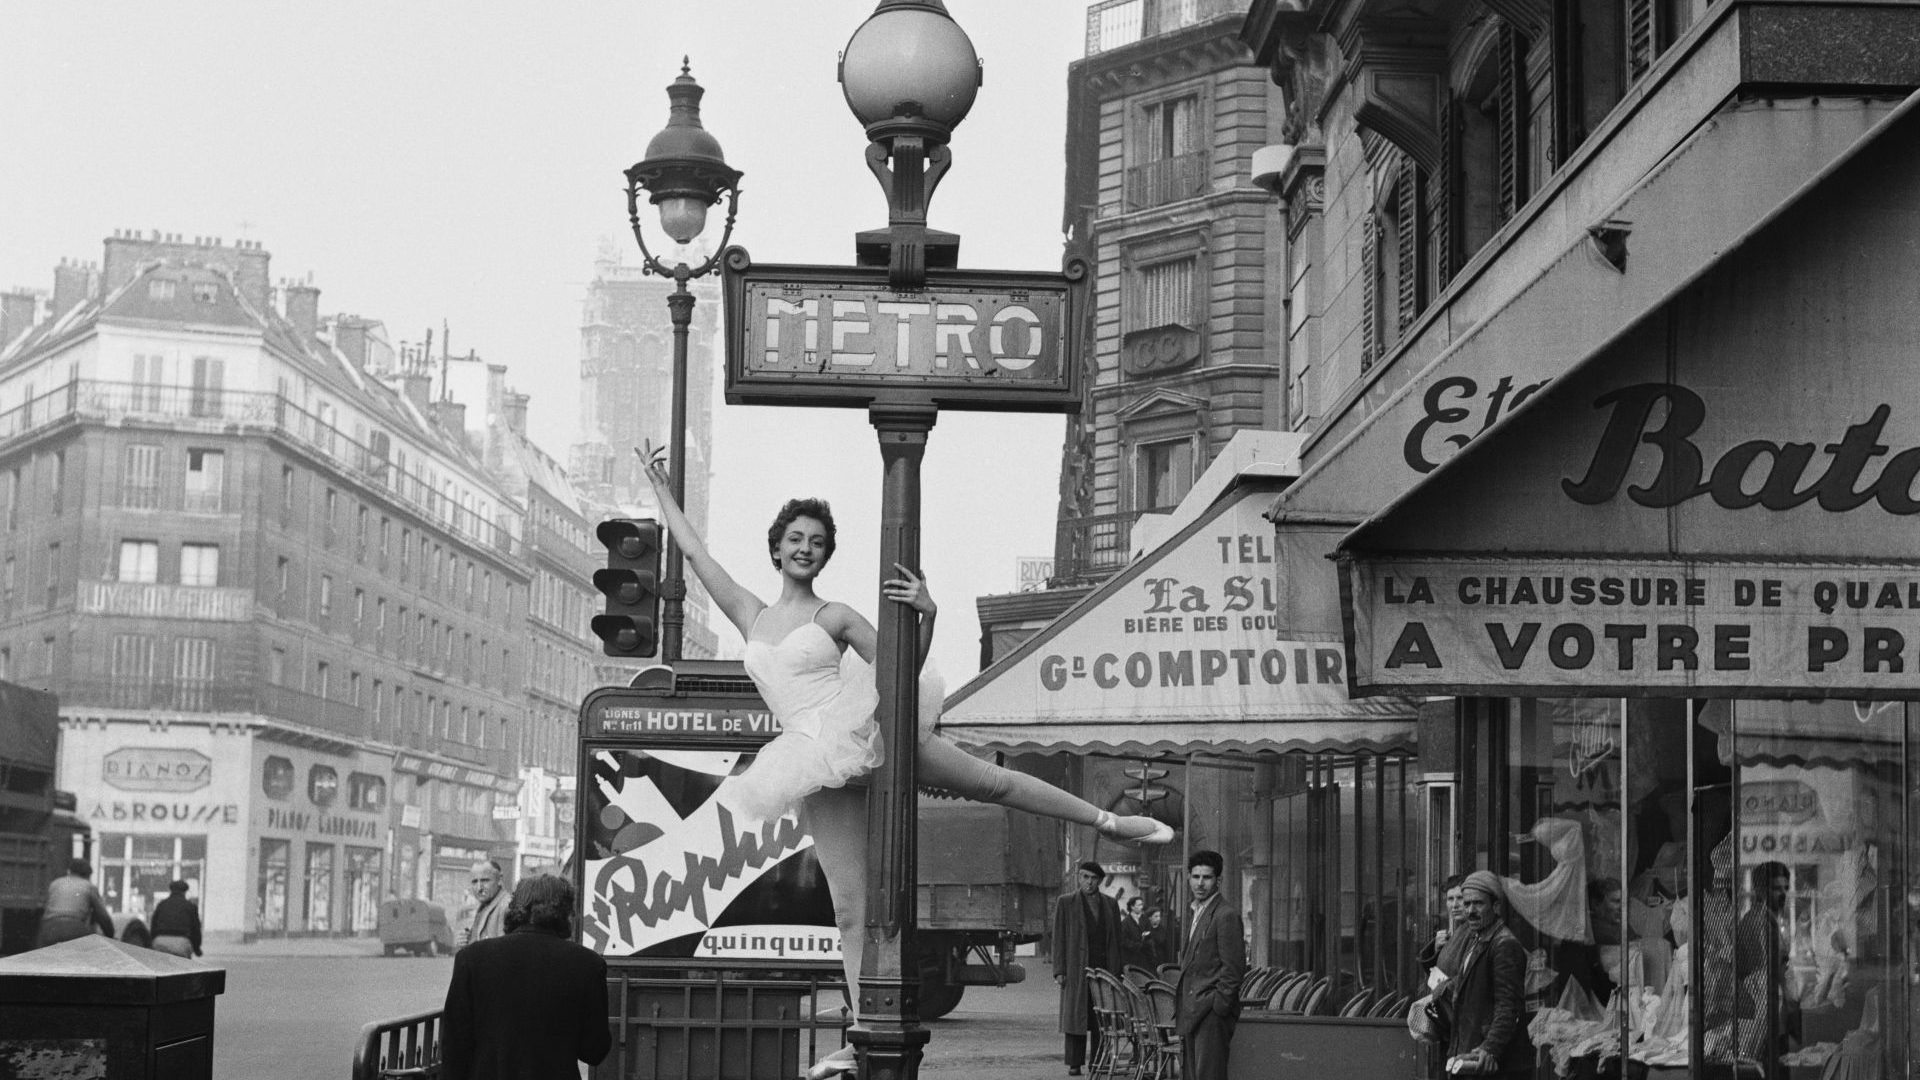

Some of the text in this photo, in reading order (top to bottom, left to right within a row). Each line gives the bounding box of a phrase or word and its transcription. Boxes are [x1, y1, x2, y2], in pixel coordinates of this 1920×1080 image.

[766, 298, 1042, 370] METRO
[1217, 534, 1277, 563] TÉL
[1144, 577, 1210, 613] La
[1383, 576, 1434, 604] LA
[1458, 576, 1706, 605] CHAUSSURE
[1735, 579, 1782, 607] DE
[1194, 616, 1228, 632] DES
[1384, 622, 1920, 673] A VOTRE PR
[1093, 648, 1344, 689] COMPTOIR
[605, 710, 640, 719] LIGNES
[647, 712, 717, 731] HOTEL
[722, 719, 742, 732] DE
